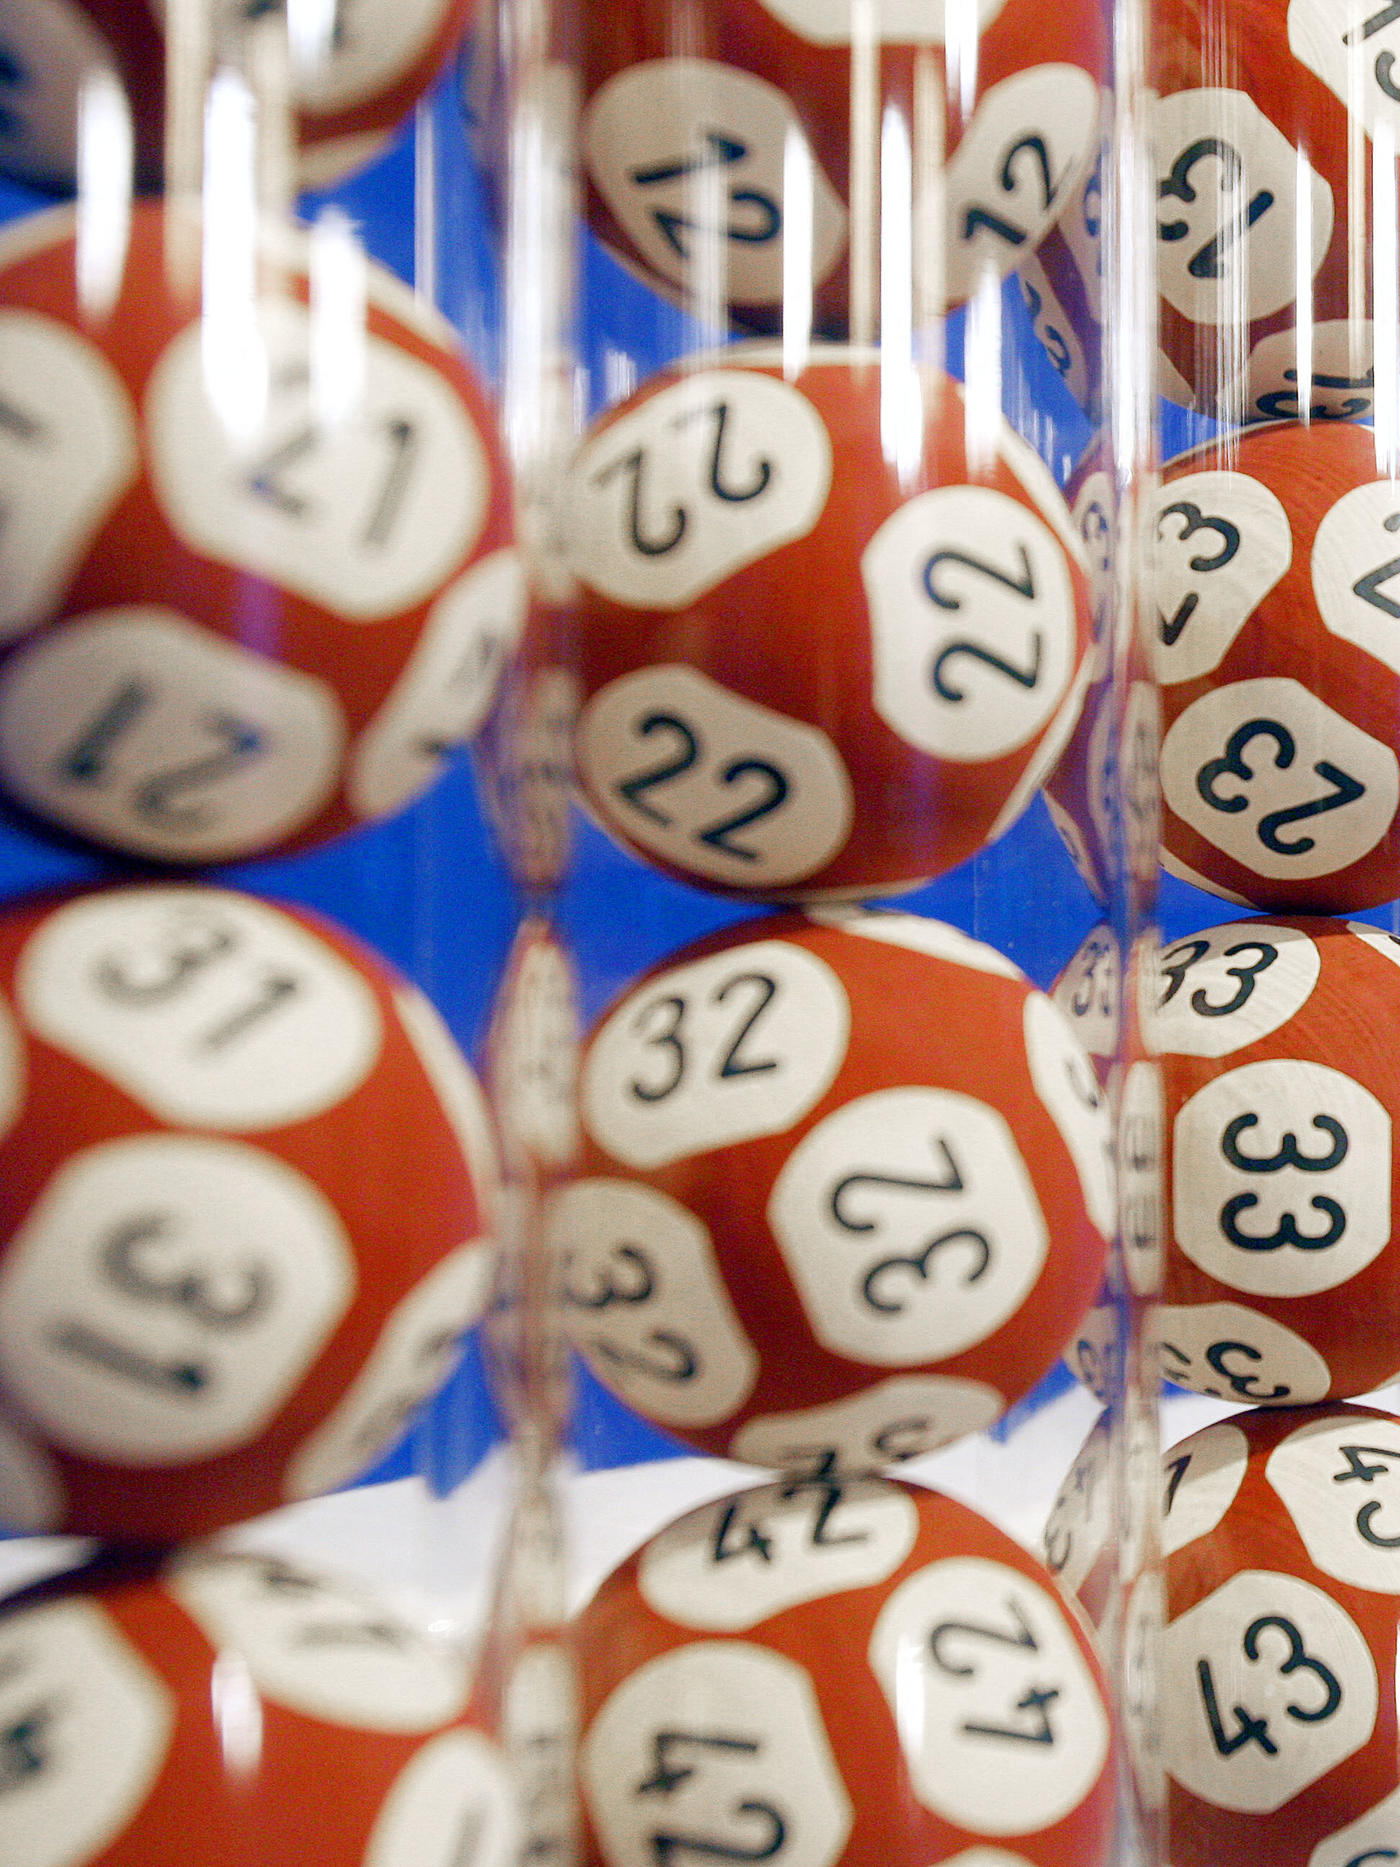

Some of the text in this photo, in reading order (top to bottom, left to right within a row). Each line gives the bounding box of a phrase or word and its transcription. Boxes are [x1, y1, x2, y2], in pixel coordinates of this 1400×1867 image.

[632, 130, 782, 260] 12
[962, 134, 1078, 248] 12
[1160, 138, 1275, 278] 13
[592, 402, 772, 558] 22
[922, 544, 1043, 704] 22
[615, 713, 790, 864] 22
[1195, 717, 1367, 855] 23
[629, 973, 779, 1103] 32
[1160, 939, 1279, 1017] 33
[832, 1138, 991, 1316] 32
[1220, 1113, 1349, 1252] 33
[45, 1205, 278, 1395] 31
[560, 1245, 697, 1382] 32
[712, 1480, 870, 1563] 42
[928, 1595, 1061, 1747] 42
[1198, 1616, 1342, 1758] 43
[637, 1730, 787, 1867] 42
